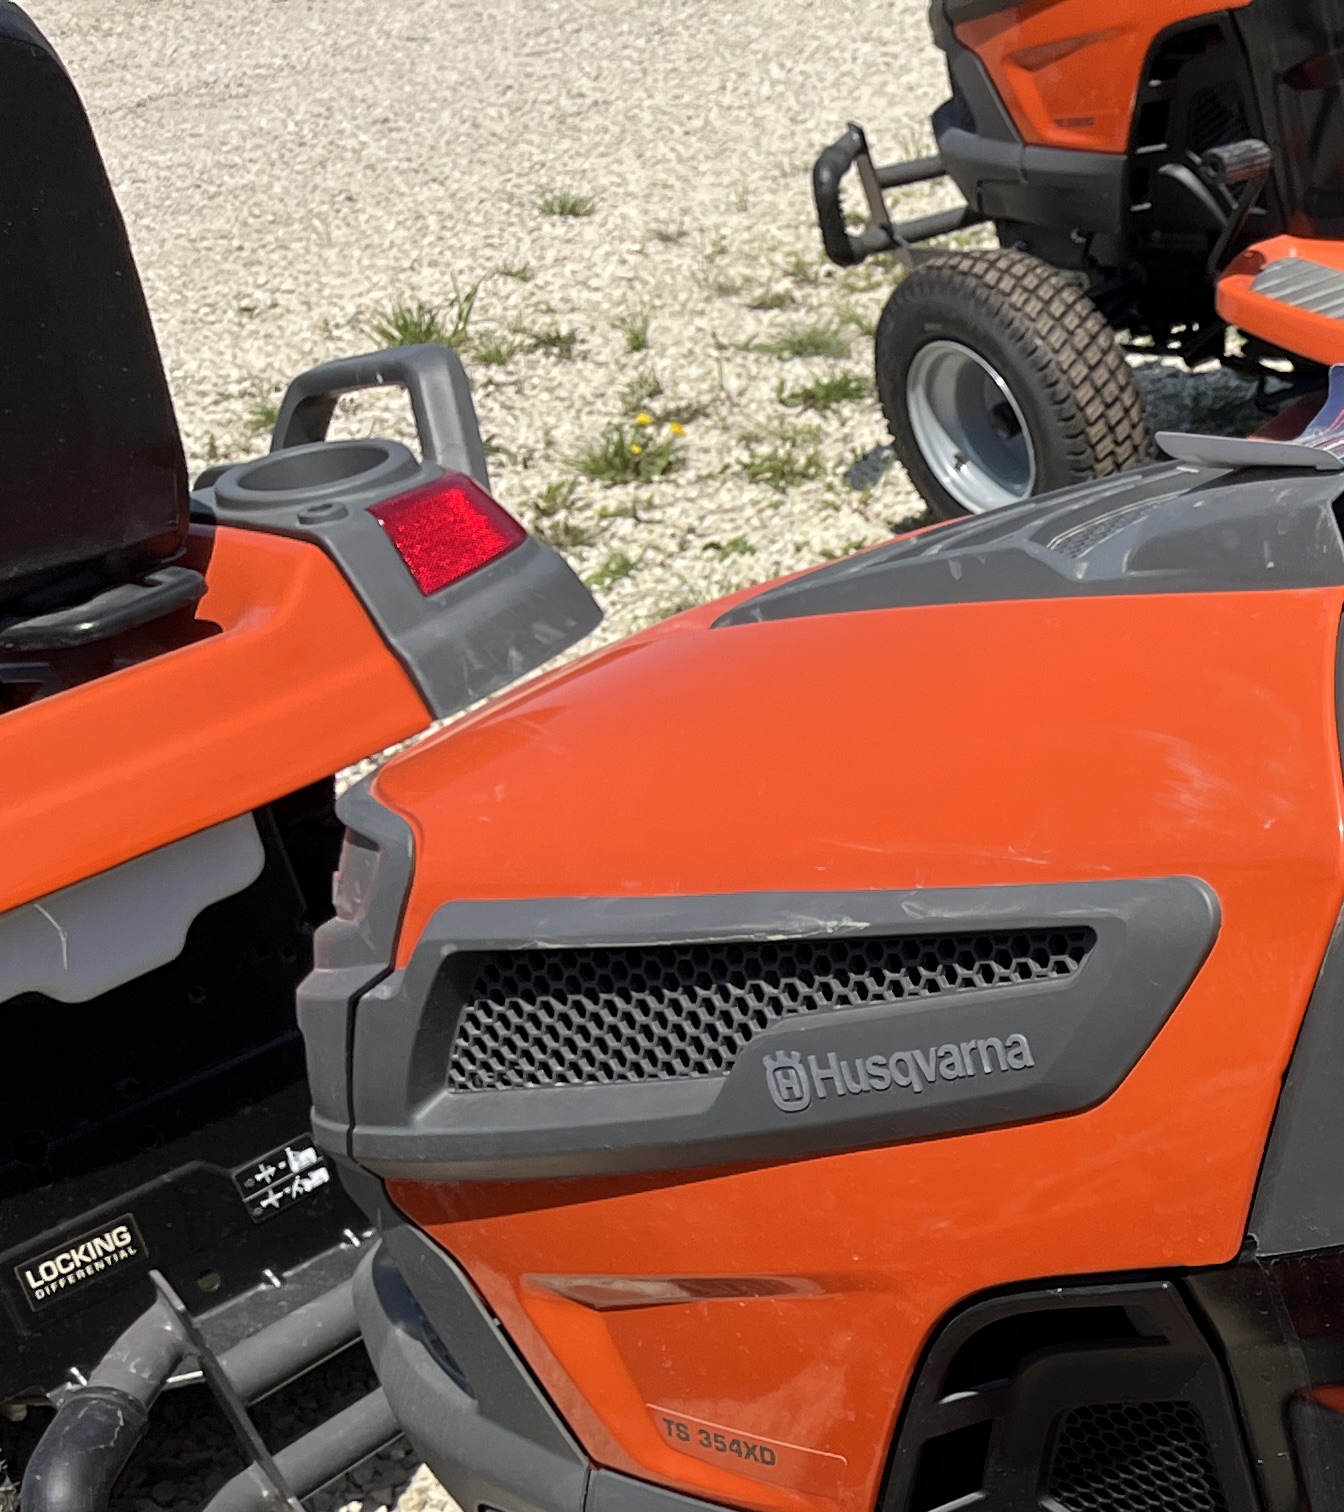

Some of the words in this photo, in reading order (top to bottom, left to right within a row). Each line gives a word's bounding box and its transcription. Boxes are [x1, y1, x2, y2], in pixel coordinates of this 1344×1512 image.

[806, 1033, 1035, 1099] Husqvarna
[25, 1224, 133, 1289] LOCKING
[34, 1245, 138, 1301] DIFFERENTIAL
[662, 1417, 691, 1442] TS
[697, 1429, 777, 1466] 354XD
